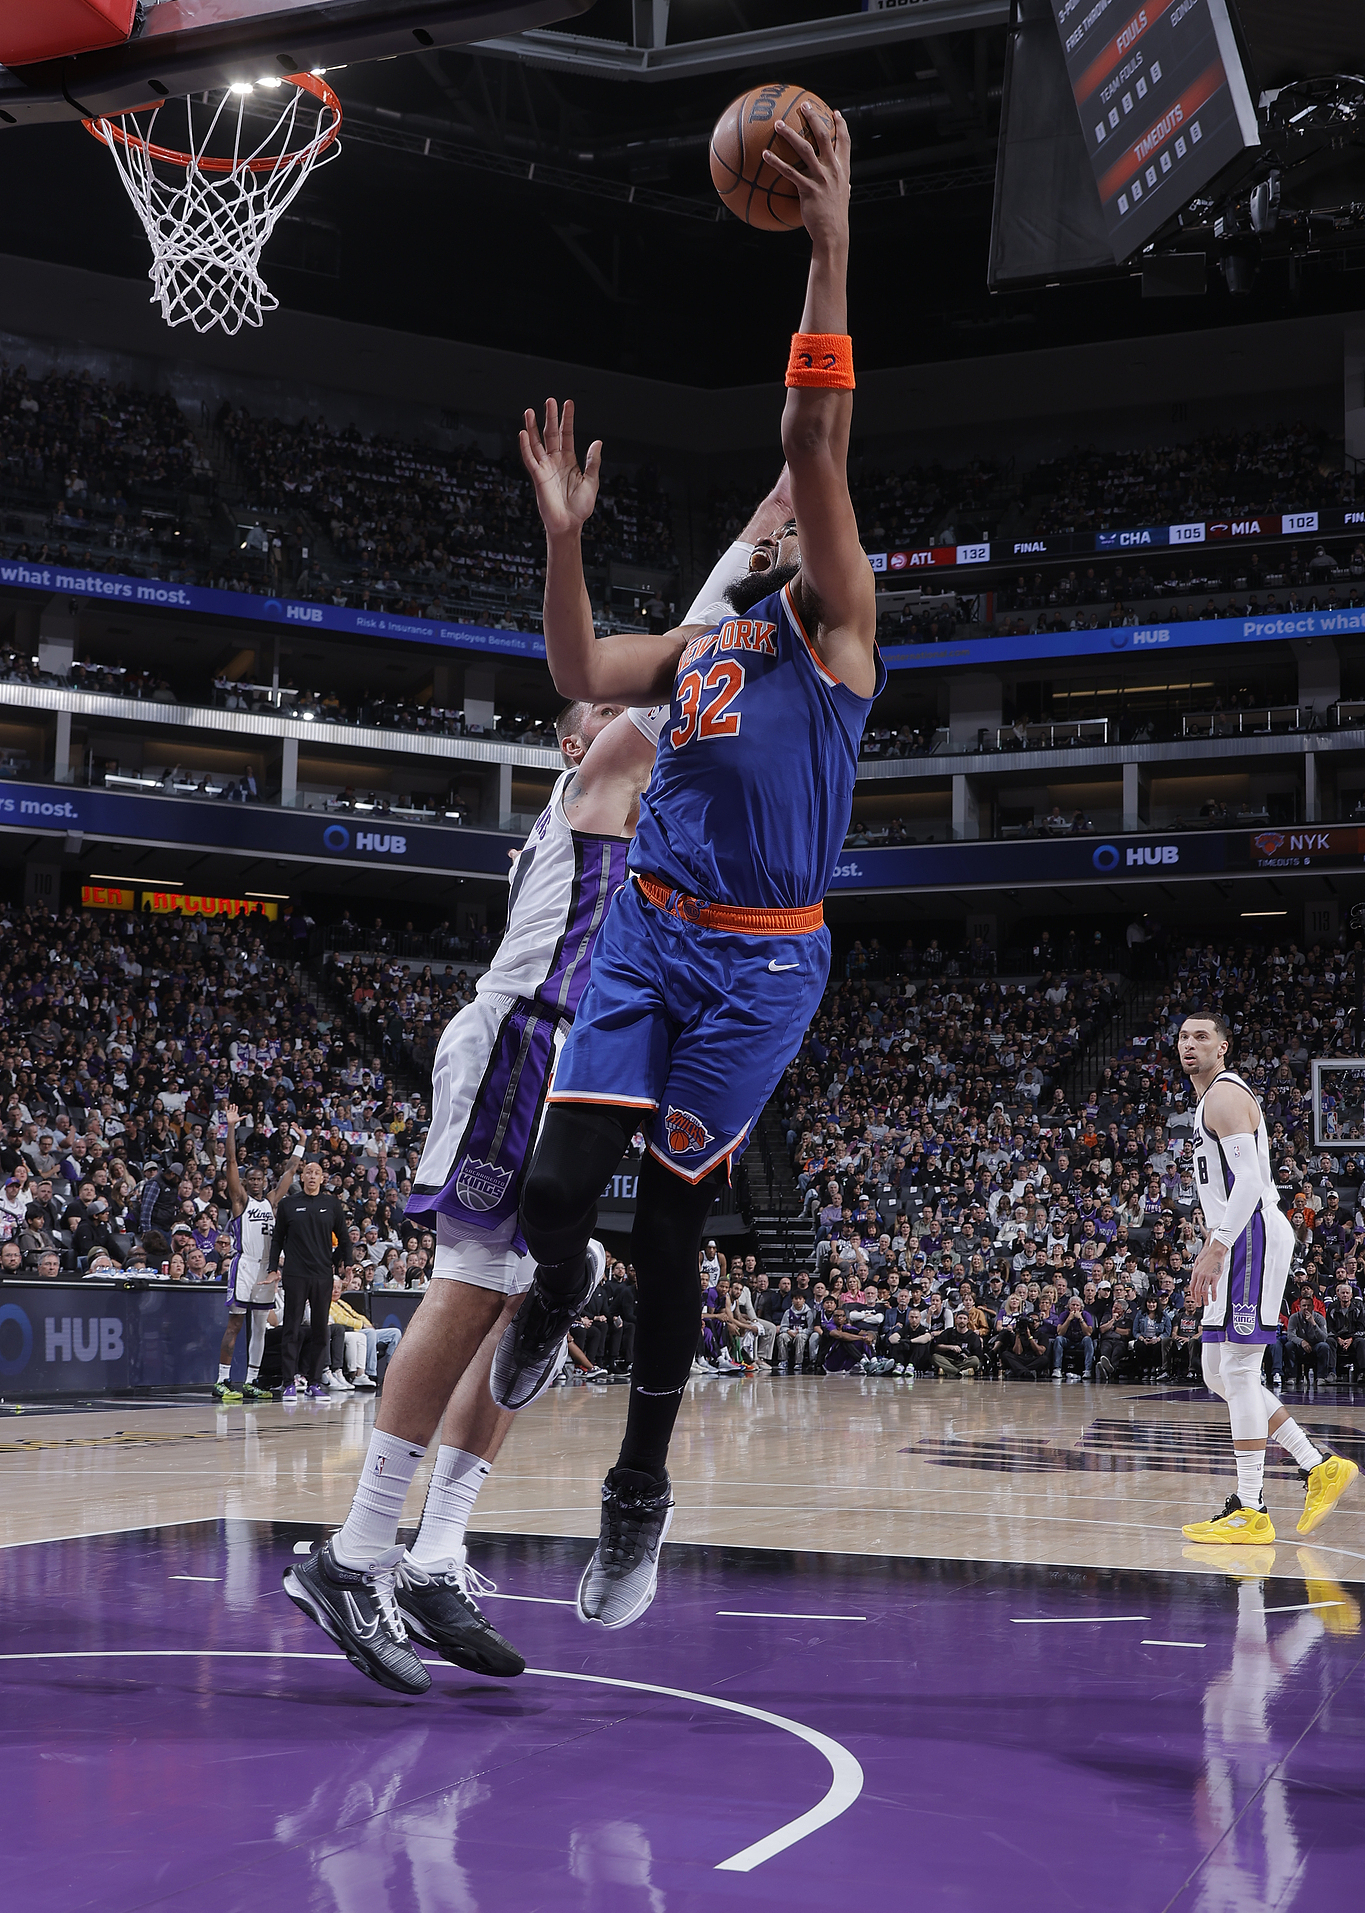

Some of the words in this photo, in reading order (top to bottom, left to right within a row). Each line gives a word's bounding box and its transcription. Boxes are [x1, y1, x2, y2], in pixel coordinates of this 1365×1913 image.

[1116, 9, 1148, 55] FOULS
[1100, 77, 1121, 105] TEAM
[1119, 50, 1144, 84] FOULS
[1133, 103, 1184, 162] TIMEOUTS
[1231, 520, 1261, 536] MIA
[1288, 517, 1314, 529] 102
[1344, 512, 1365, 524] FIN
[1119, 531, 1151, 546] CHA
[1176, 527, 1201, 539] 105
[909, 551, 935, 567] ATL
[962, 548, 986, 560] 132
[1013, 541, 1047, 554] FINAL
[0, 566, 51, 586] what
[55, 575, 132, 597] matters
[137, 586, 191, 605] most.
[286, 605, 323, 623] HUB
[356, 617, 377, 628] Risk
[378, 620, 386, 629] &
[388, 621, 433, 636] Insurance
[1243, 617, 1314, 637] Protect
[440, 629, 486, 643] Employee
[488, 635, 526, 649] Benefits
[712, 619, 777, 658] ORK
[1133, 629, 1170, 645] HUB
[670, 658, 746, 750] 32
[20, 800, 78, 818] most.
[356, 831, 407, 854] HUB
[1290, 833, 1330, 851] NYK
[1126, 846, 1179, 866] HUB
[1258, 858, 1300, 867] TIMEOUTS
[666, 1111, 705, 1148] KNICKS
[459, 1173, 504, 1199] KINGS
[45, 1317, 124, 1362] HUB
